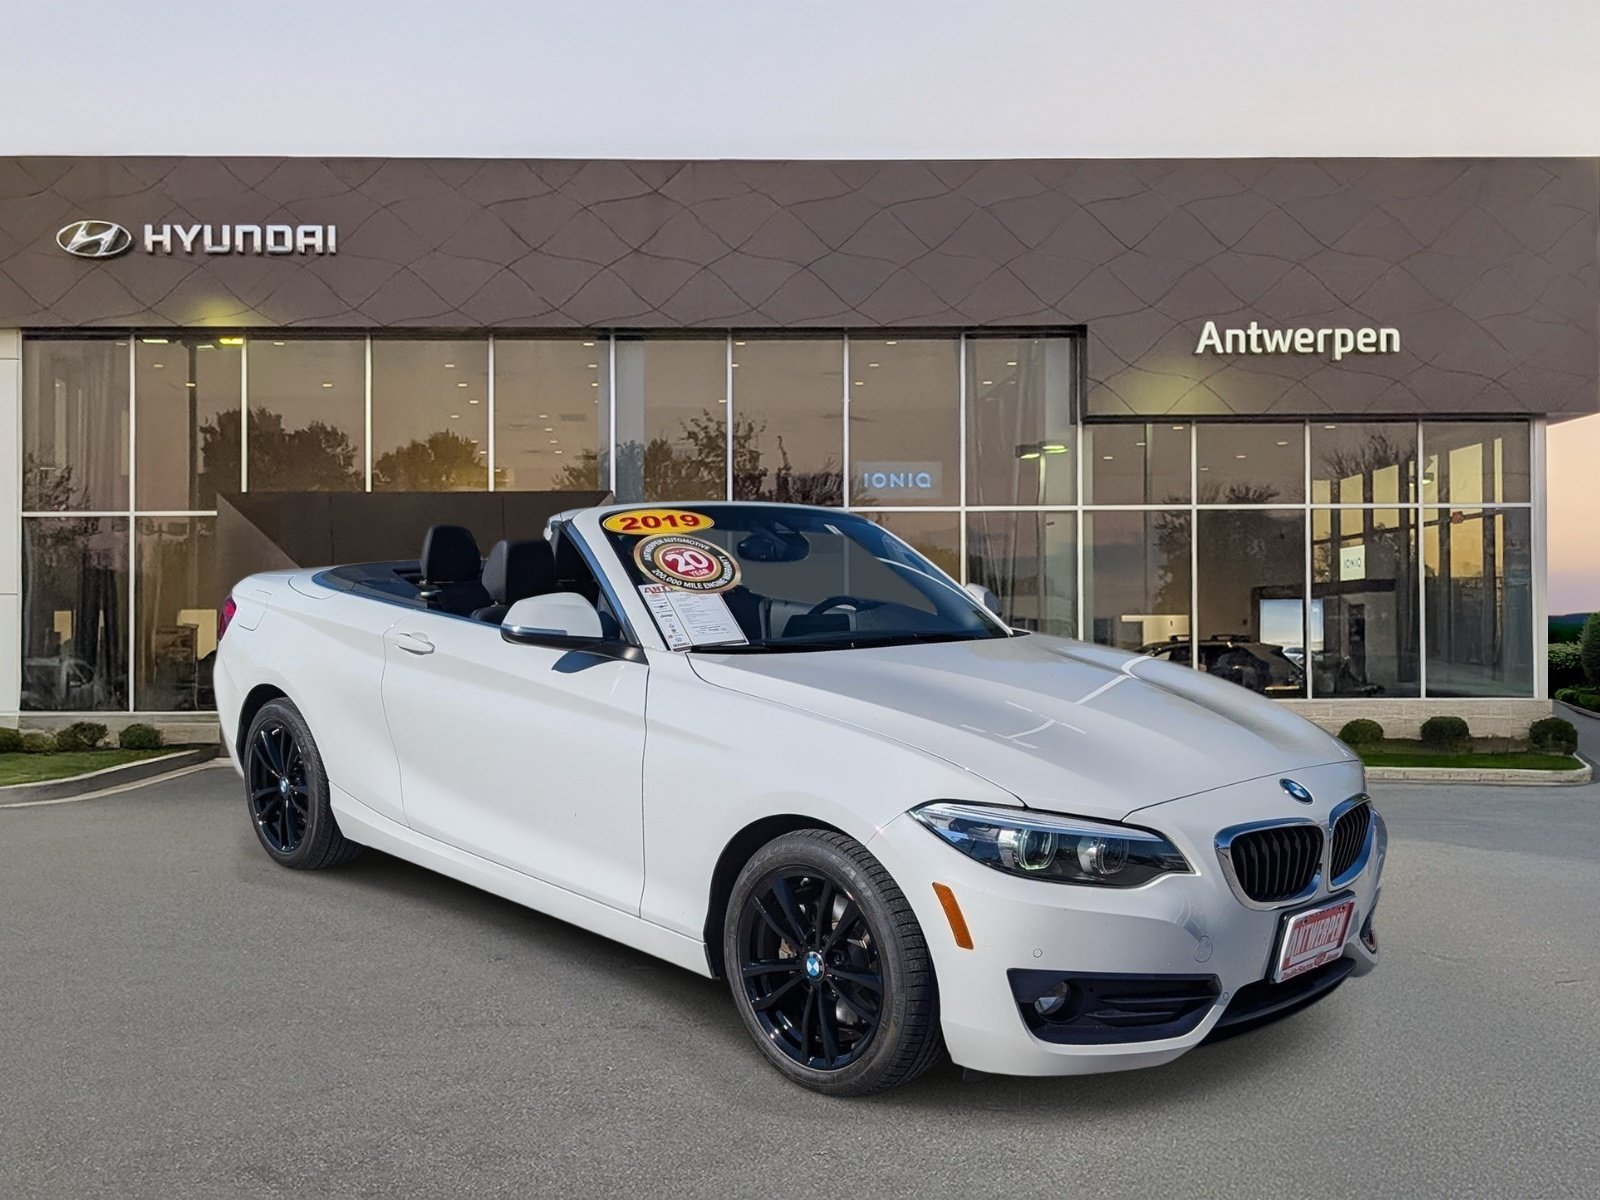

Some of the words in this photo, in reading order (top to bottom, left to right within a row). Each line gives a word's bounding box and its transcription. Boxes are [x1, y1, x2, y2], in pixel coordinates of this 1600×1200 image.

[144, 224, 336, 253] HYUNDAI
[1195, 321, 1400, 360] Antwerpen
[863, 472, 932, 488] IONIQ
[620, 514, 700, 531] 2019
[664, 537, 710, 550] AUTOMOTIVE
[664, 550, 709, 573] 20
[652, 569, 682, 586] 200,000
[690, 568, 711, 577] YEAR
